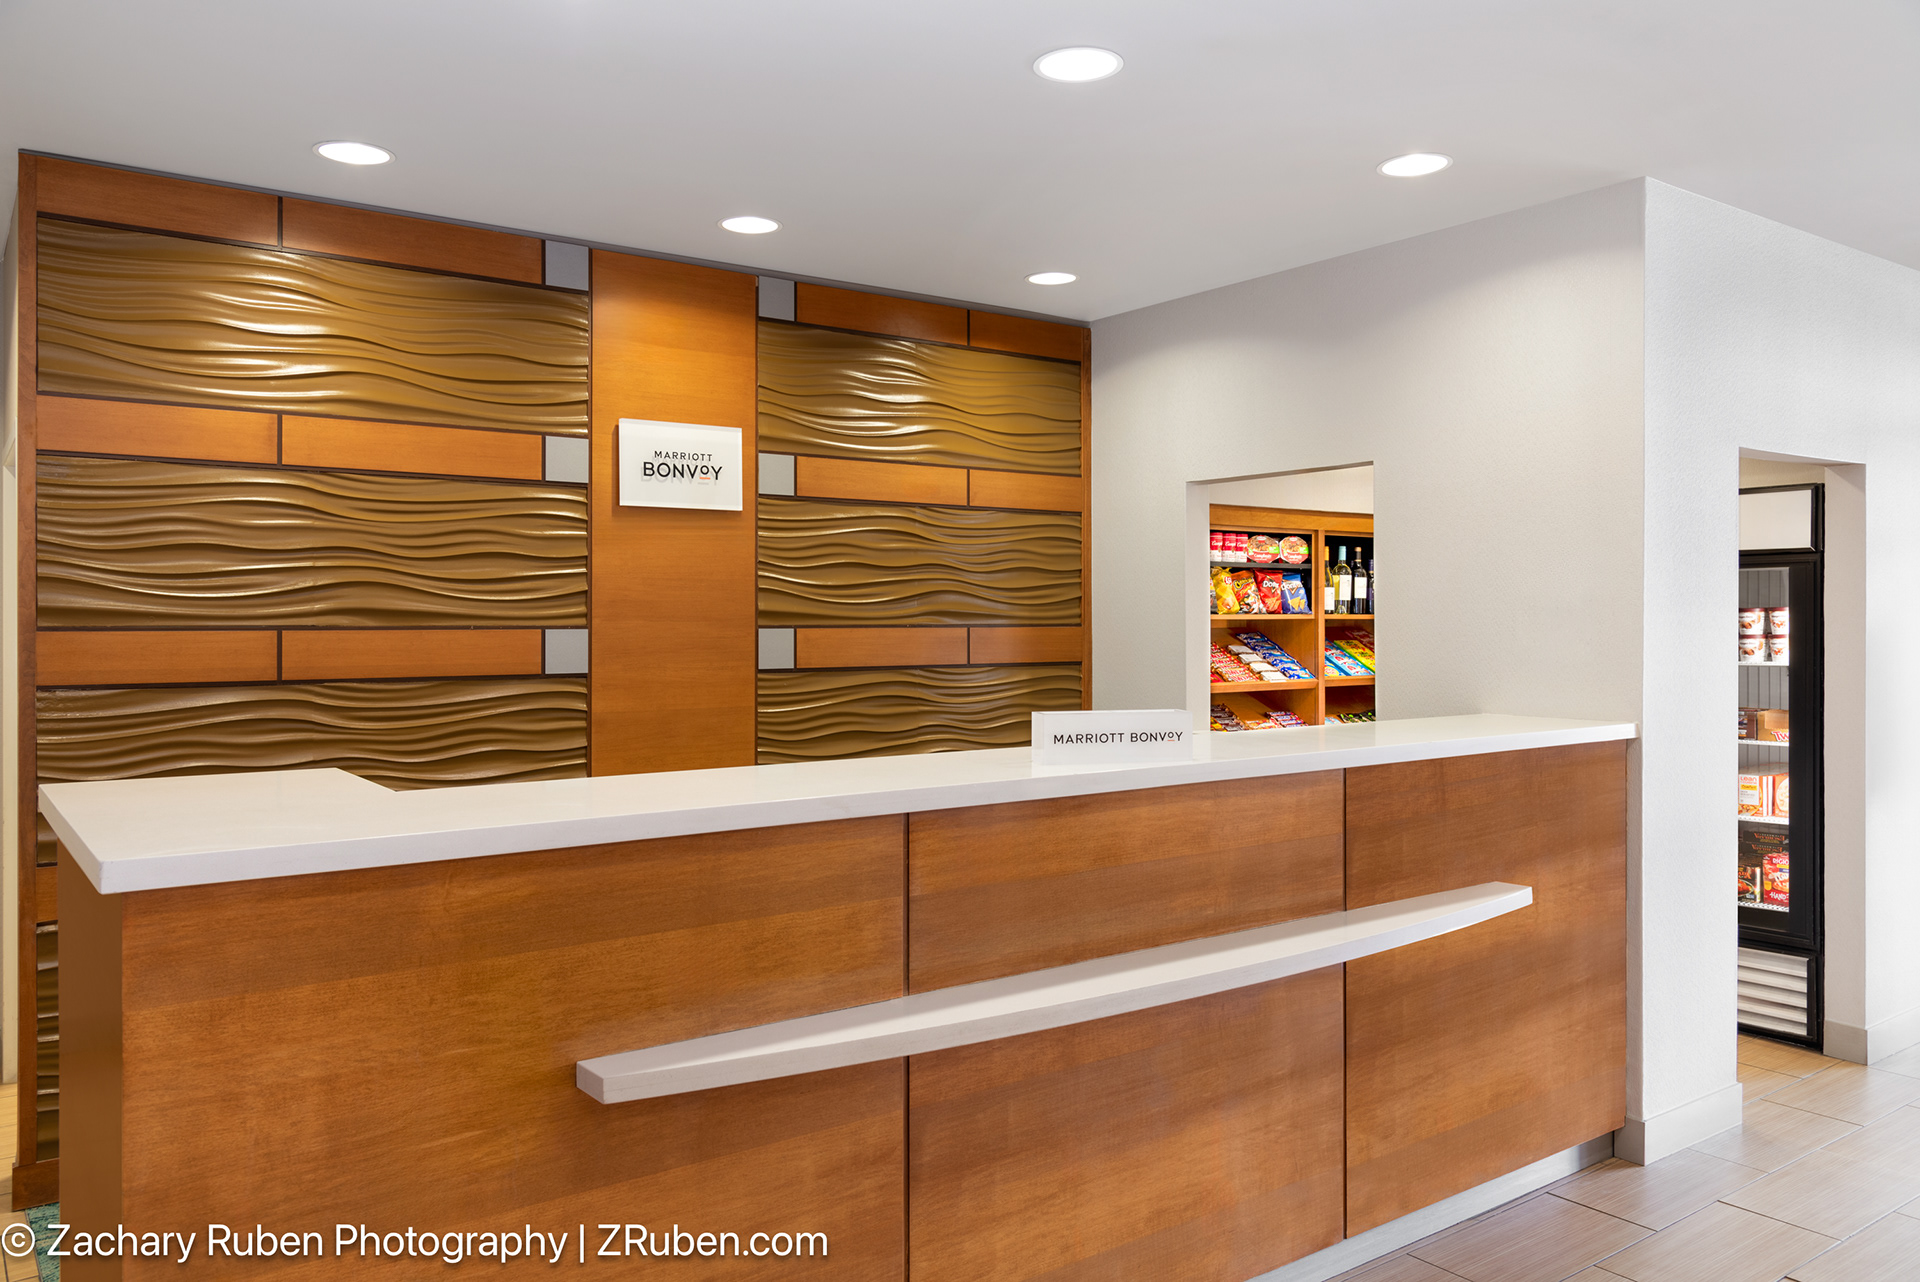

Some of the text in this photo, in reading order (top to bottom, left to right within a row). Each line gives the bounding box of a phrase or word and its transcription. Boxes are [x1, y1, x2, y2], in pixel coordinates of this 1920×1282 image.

[654, 450, 713, 462] MARRIOTT
[643, 461, 723, 481] BONVOY
[1053, 731, 1183, 745] MARRIOTT BONVOY
